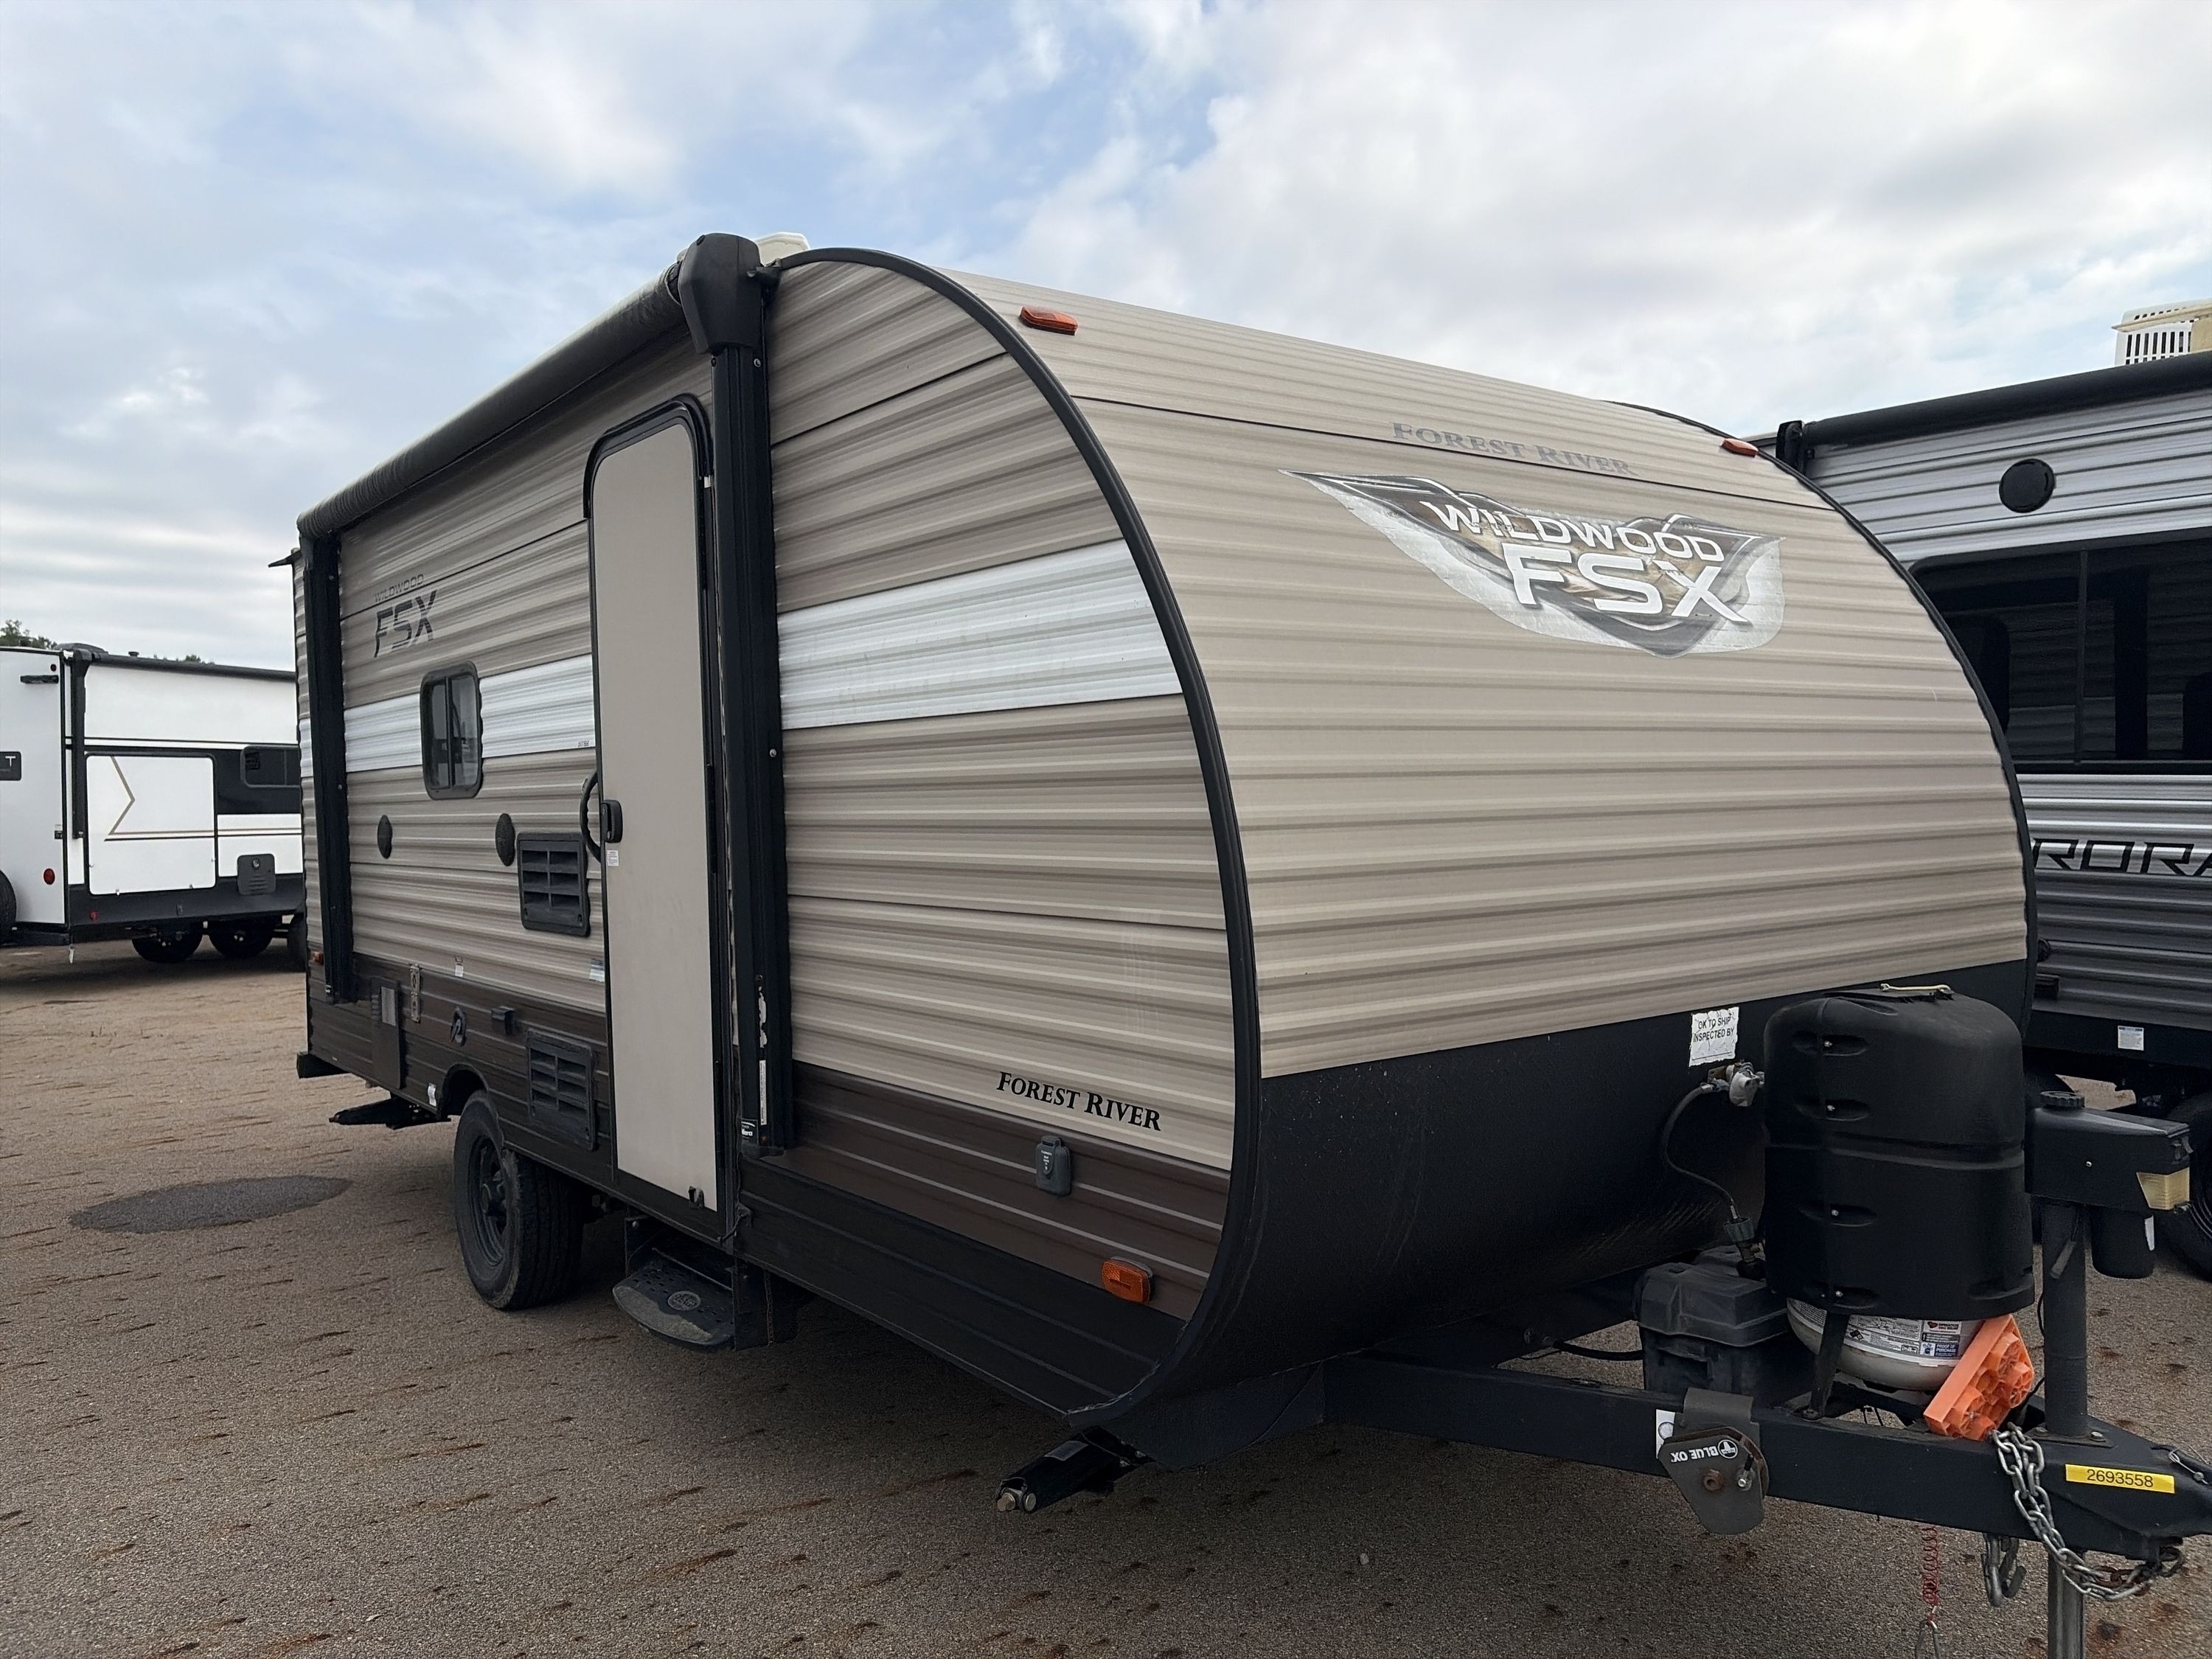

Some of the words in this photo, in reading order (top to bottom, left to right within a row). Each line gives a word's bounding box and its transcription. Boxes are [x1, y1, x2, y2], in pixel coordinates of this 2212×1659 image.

[1392, 422, 1526, 459] FOREST
[1534, 444, 1639, 476] RIVER
[1419, 501, 1725, 562] WILDWOOD
[375, 574, 424, 603] WILDWOOD
[1502, 542, 1750, 624] FSX
[374, 589, 437, 658] FSX
[1693, 1029, 1725, 1043] INSPECTED
[1726, 1027, 1735, 1037] BY
[1698, 1020, 1707, 1029] OK
[1708, 1018, 1717, 1029] TO
[1717, 1017, 1731, 1026] SHIP
[996, 1071, 1081, 1109] FOREST
[1084, 1091, 1161, 1132] RIVER
[1670, 1450, 1688, 1463] OX
[1688, 1445, 1719, 1460] BLUE
[2087, 1469, 2154, 1488] 2693558
